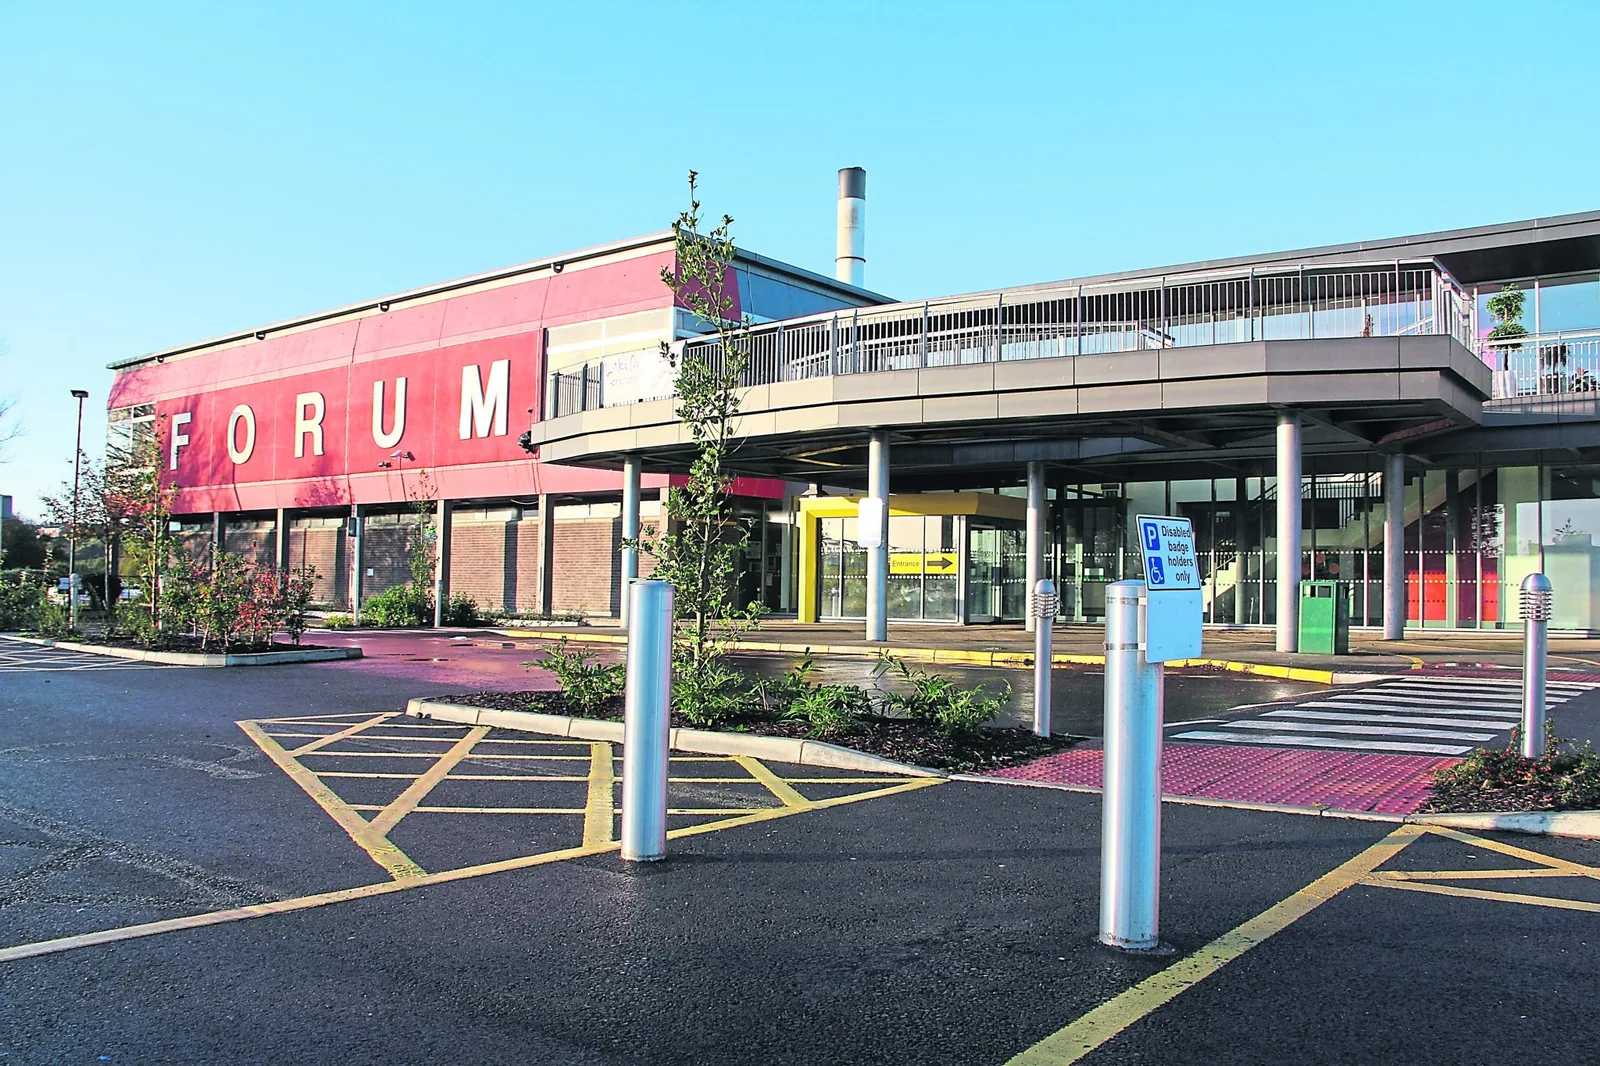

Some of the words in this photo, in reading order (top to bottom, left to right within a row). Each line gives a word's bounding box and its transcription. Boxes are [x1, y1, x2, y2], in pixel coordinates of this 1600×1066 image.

[169, 359, 511, 471] FORUM
[1146, 525, 1158, 548] P
[1161, 525, 1191, 538] Disabled
[1168, 541, 1189, 555] badge
[1167, 555, 1194, 567] holders
[1175, 570, 1191, 584] only
